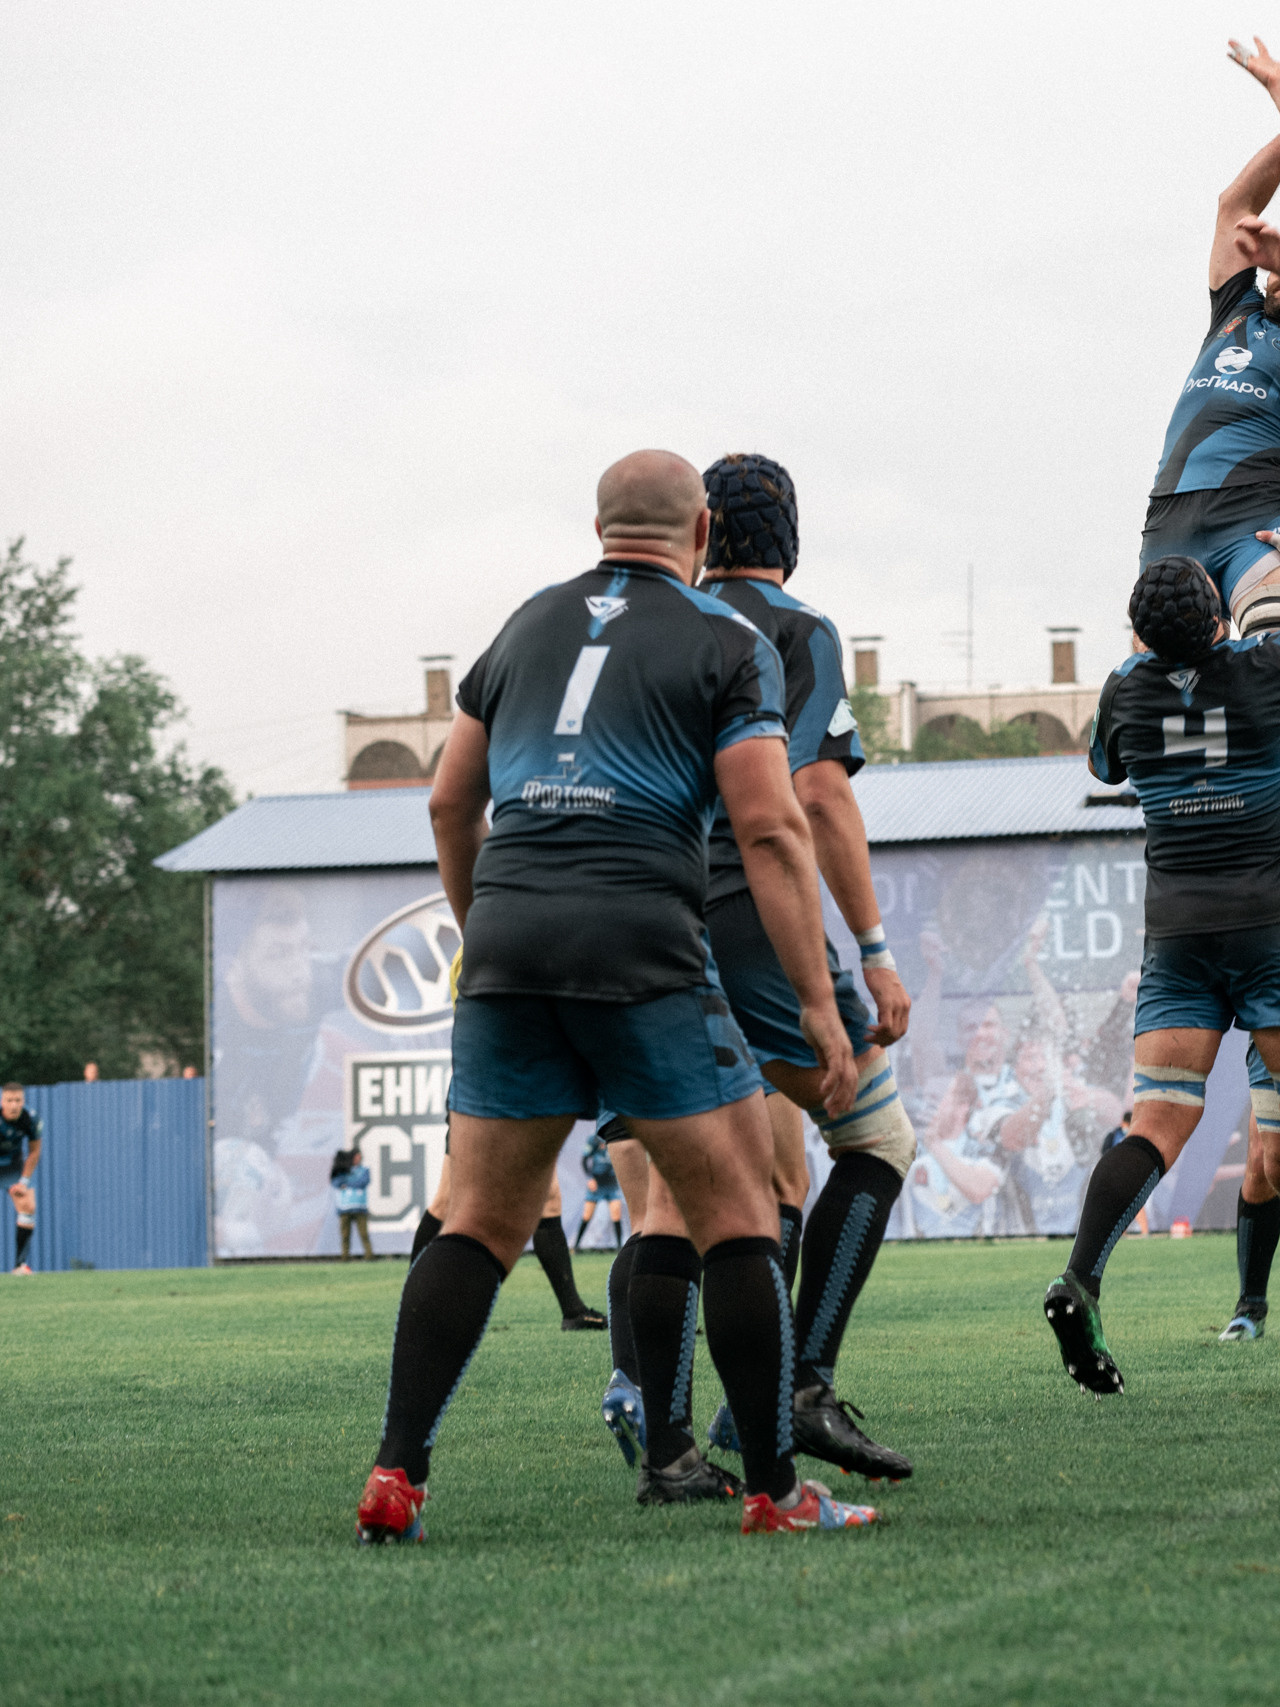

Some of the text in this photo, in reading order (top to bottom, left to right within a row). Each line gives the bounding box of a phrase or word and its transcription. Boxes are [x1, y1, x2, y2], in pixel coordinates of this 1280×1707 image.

[554, 645, 611, 735] 1
[1163, 706, 1228, 768] 4
[358, 1066, 451, 1117] ЕНИ
